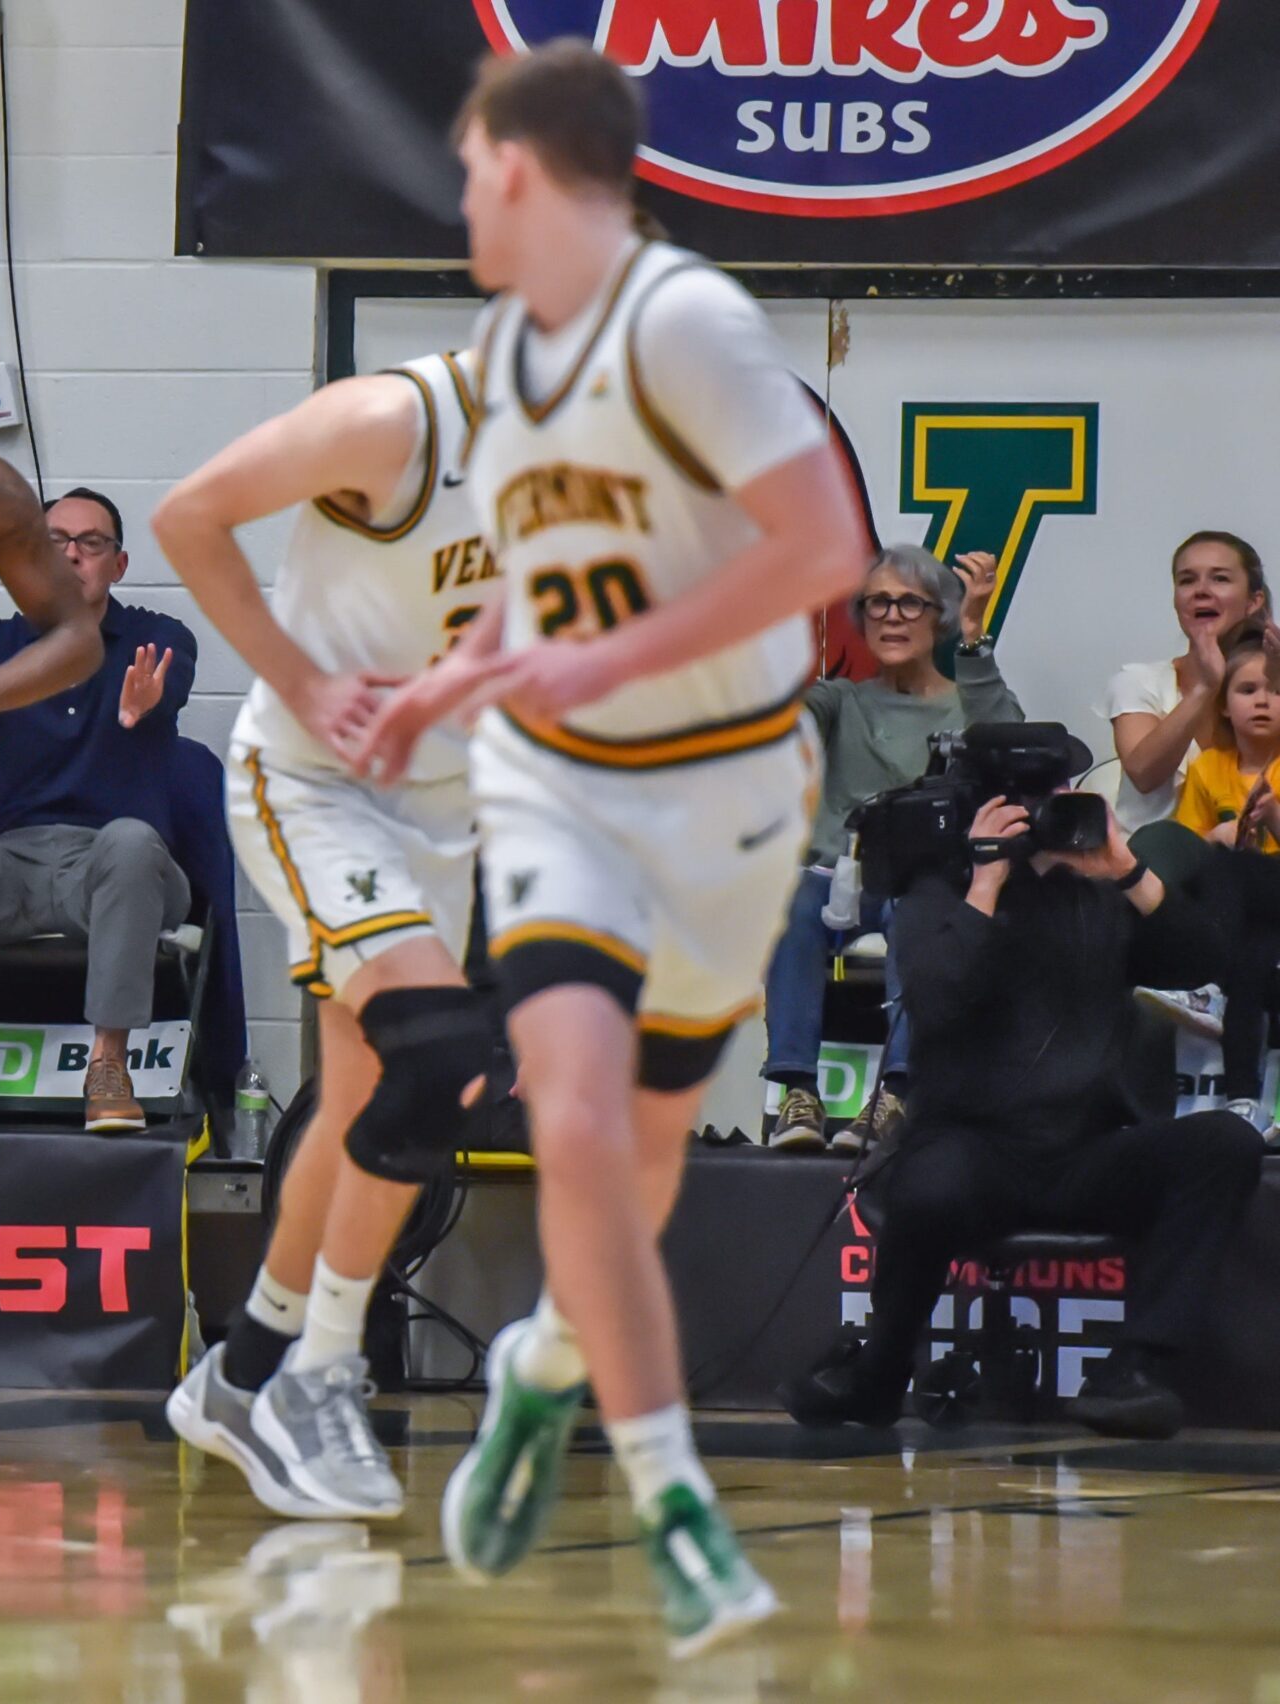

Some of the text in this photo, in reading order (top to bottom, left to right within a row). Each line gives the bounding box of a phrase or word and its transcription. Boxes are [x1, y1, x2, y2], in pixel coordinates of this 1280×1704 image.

[736, 101, 931, 154] SUBS
[527, 556, 654, 645] 20
[939, 815, 946, 829] 5
[57, 1038, 174, 1072] Bnk
